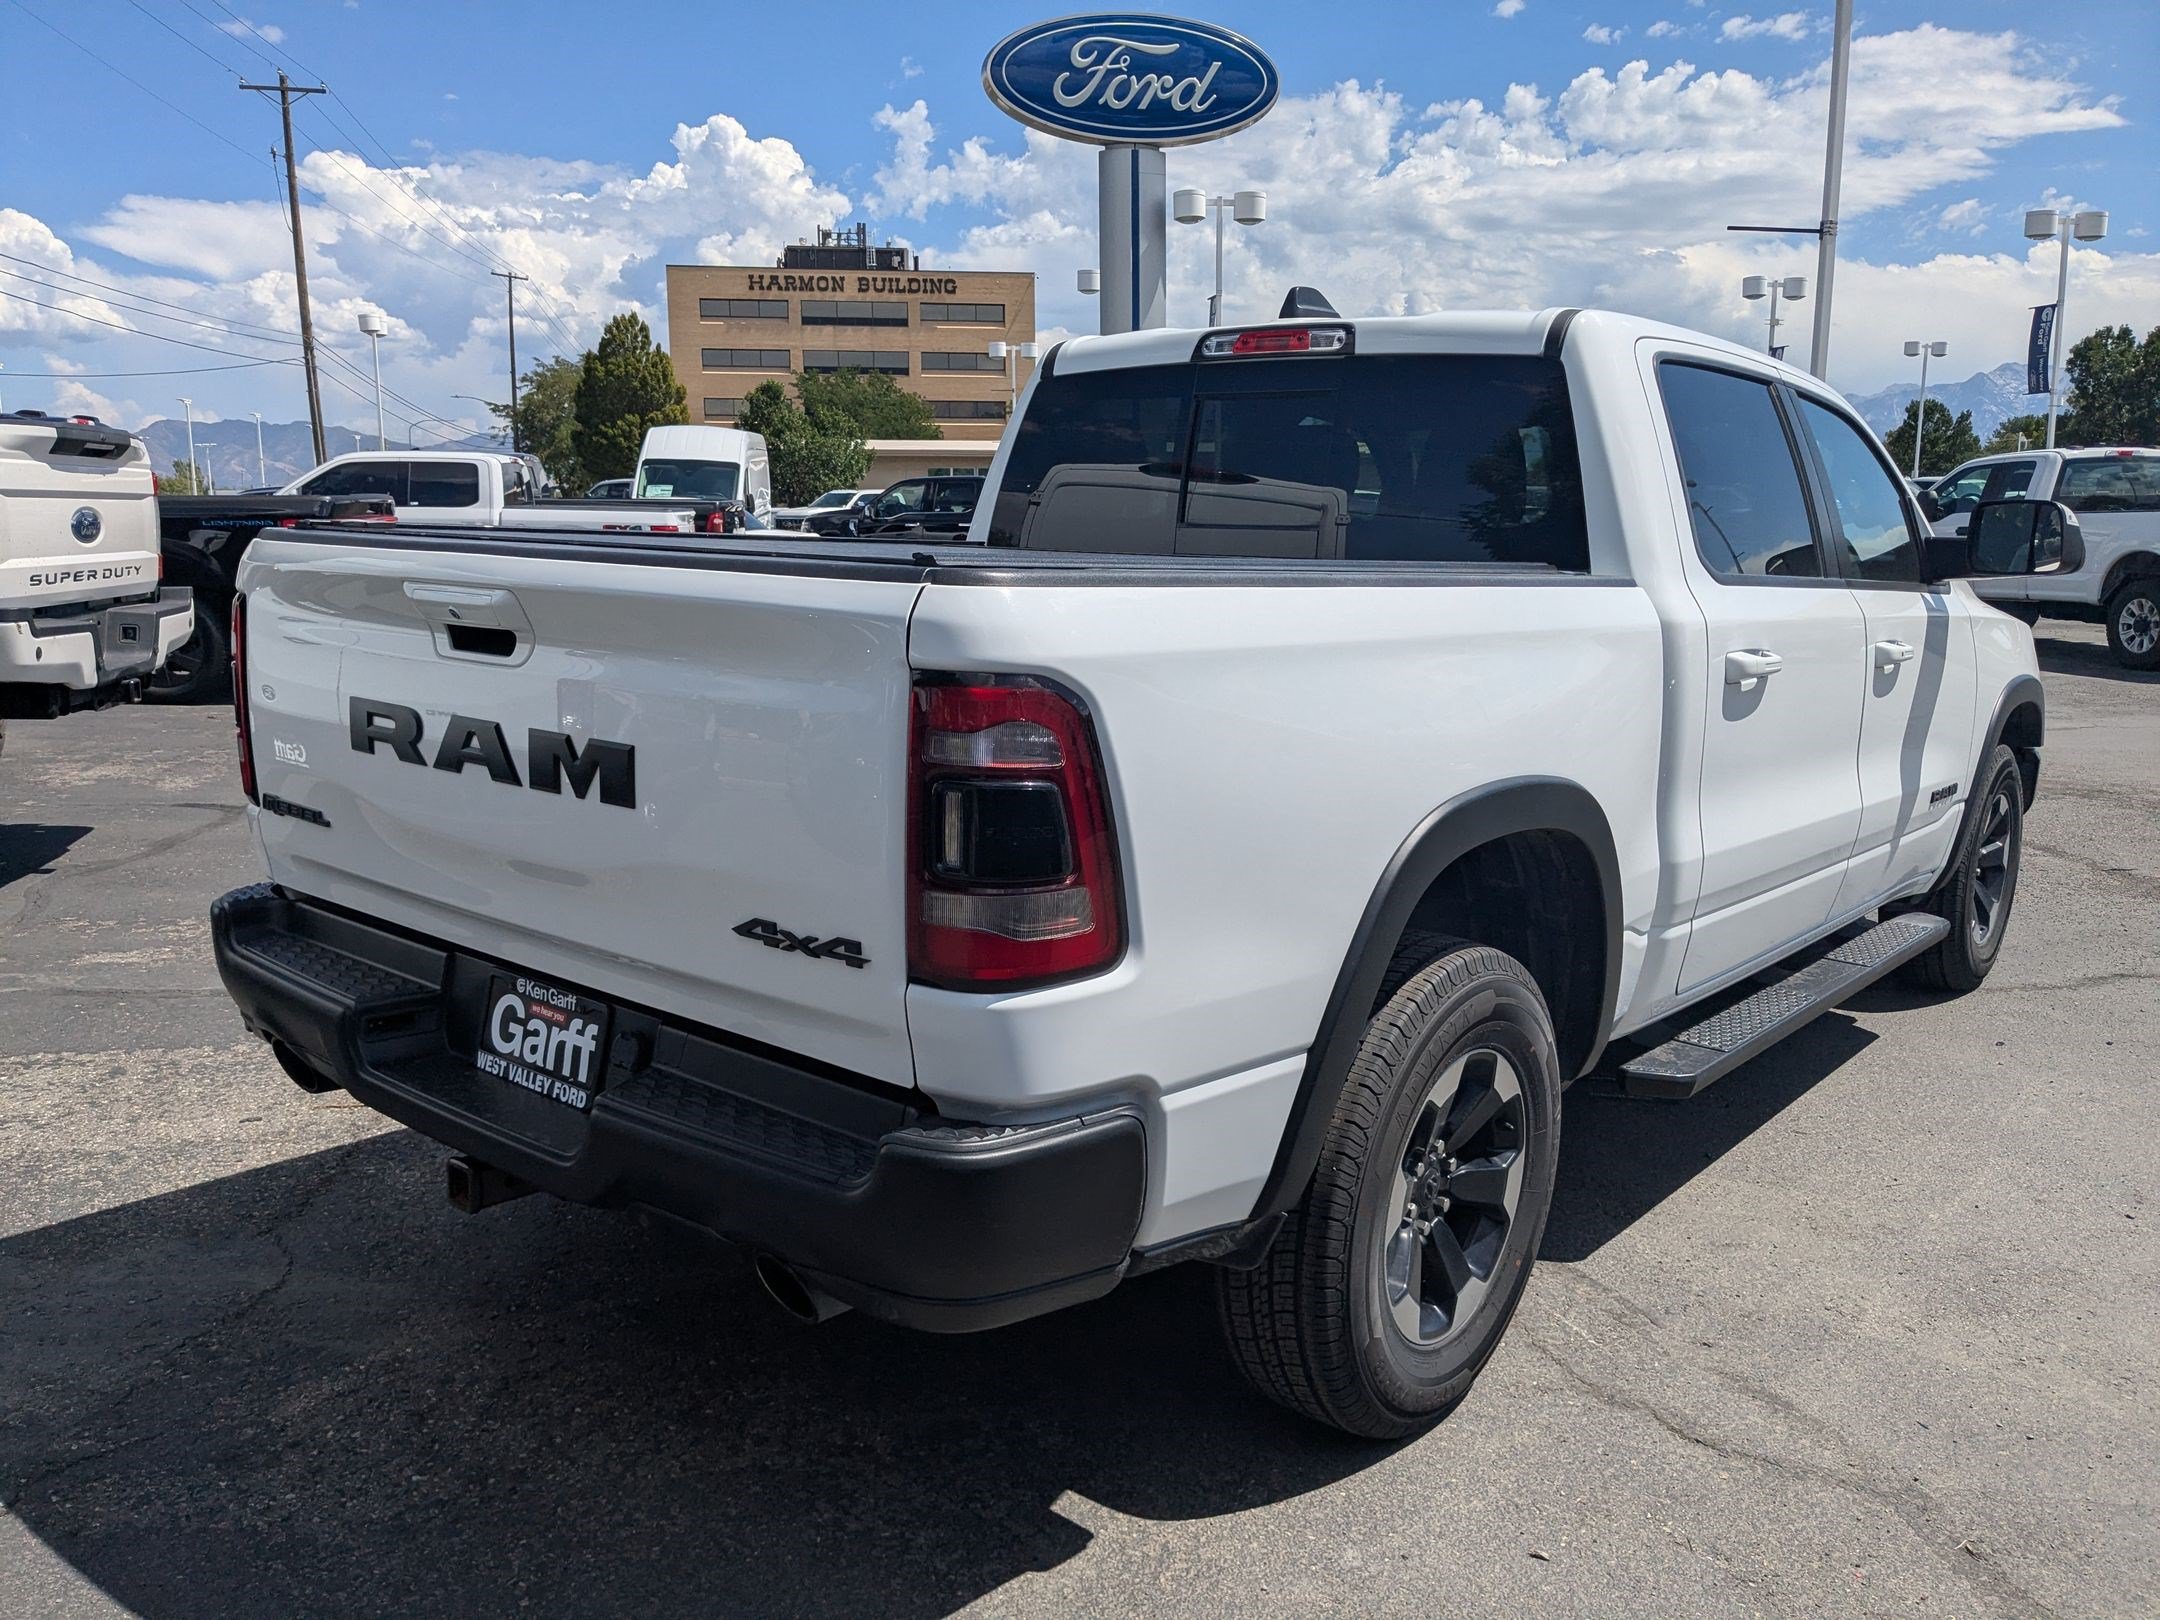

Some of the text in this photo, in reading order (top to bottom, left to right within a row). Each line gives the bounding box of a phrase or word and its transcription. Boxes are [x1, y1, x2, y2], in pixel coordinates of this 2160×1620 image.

[1053, 36, 1222, 113] Ford
[748, 274, 958, 295] HARMON BUILDING
[2037, 323, 2046, 345] Ford
[29, 565, 142, 587] SUPER DUTY
[350, 695, 636, 810] RAM
[491, 993, 599, 1083] Garff
[477, 1051, 587, 1109] WEST VALLEY FORD
